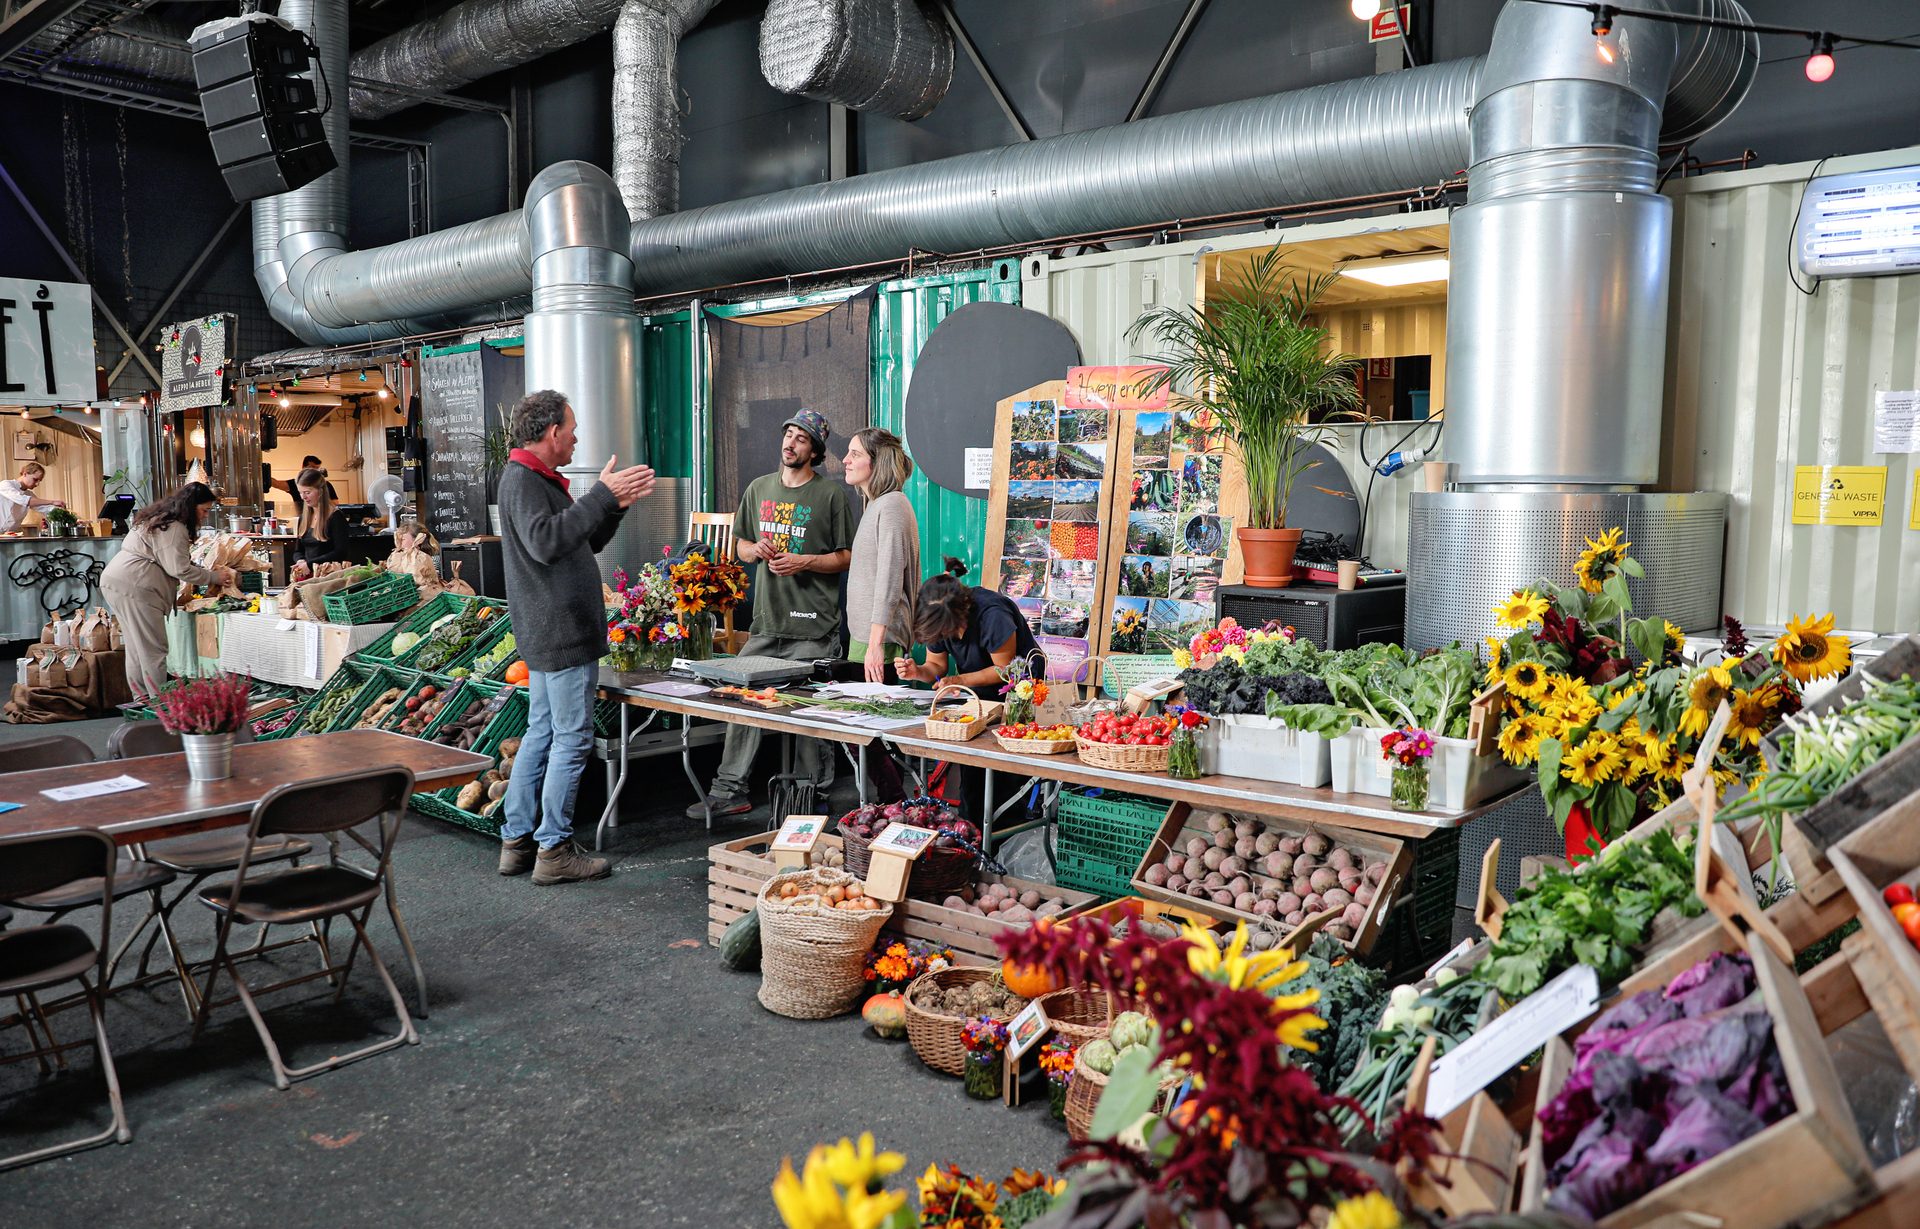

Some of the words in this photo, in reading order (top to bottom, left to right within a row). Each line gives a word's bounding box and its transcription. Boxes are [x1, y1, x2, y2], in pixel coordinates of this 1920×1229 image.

[173, 383, 188, 393] ALEPPO
[1844, 493, 1878, 502] WASTE
[791, 526, 807, 538] EAT
